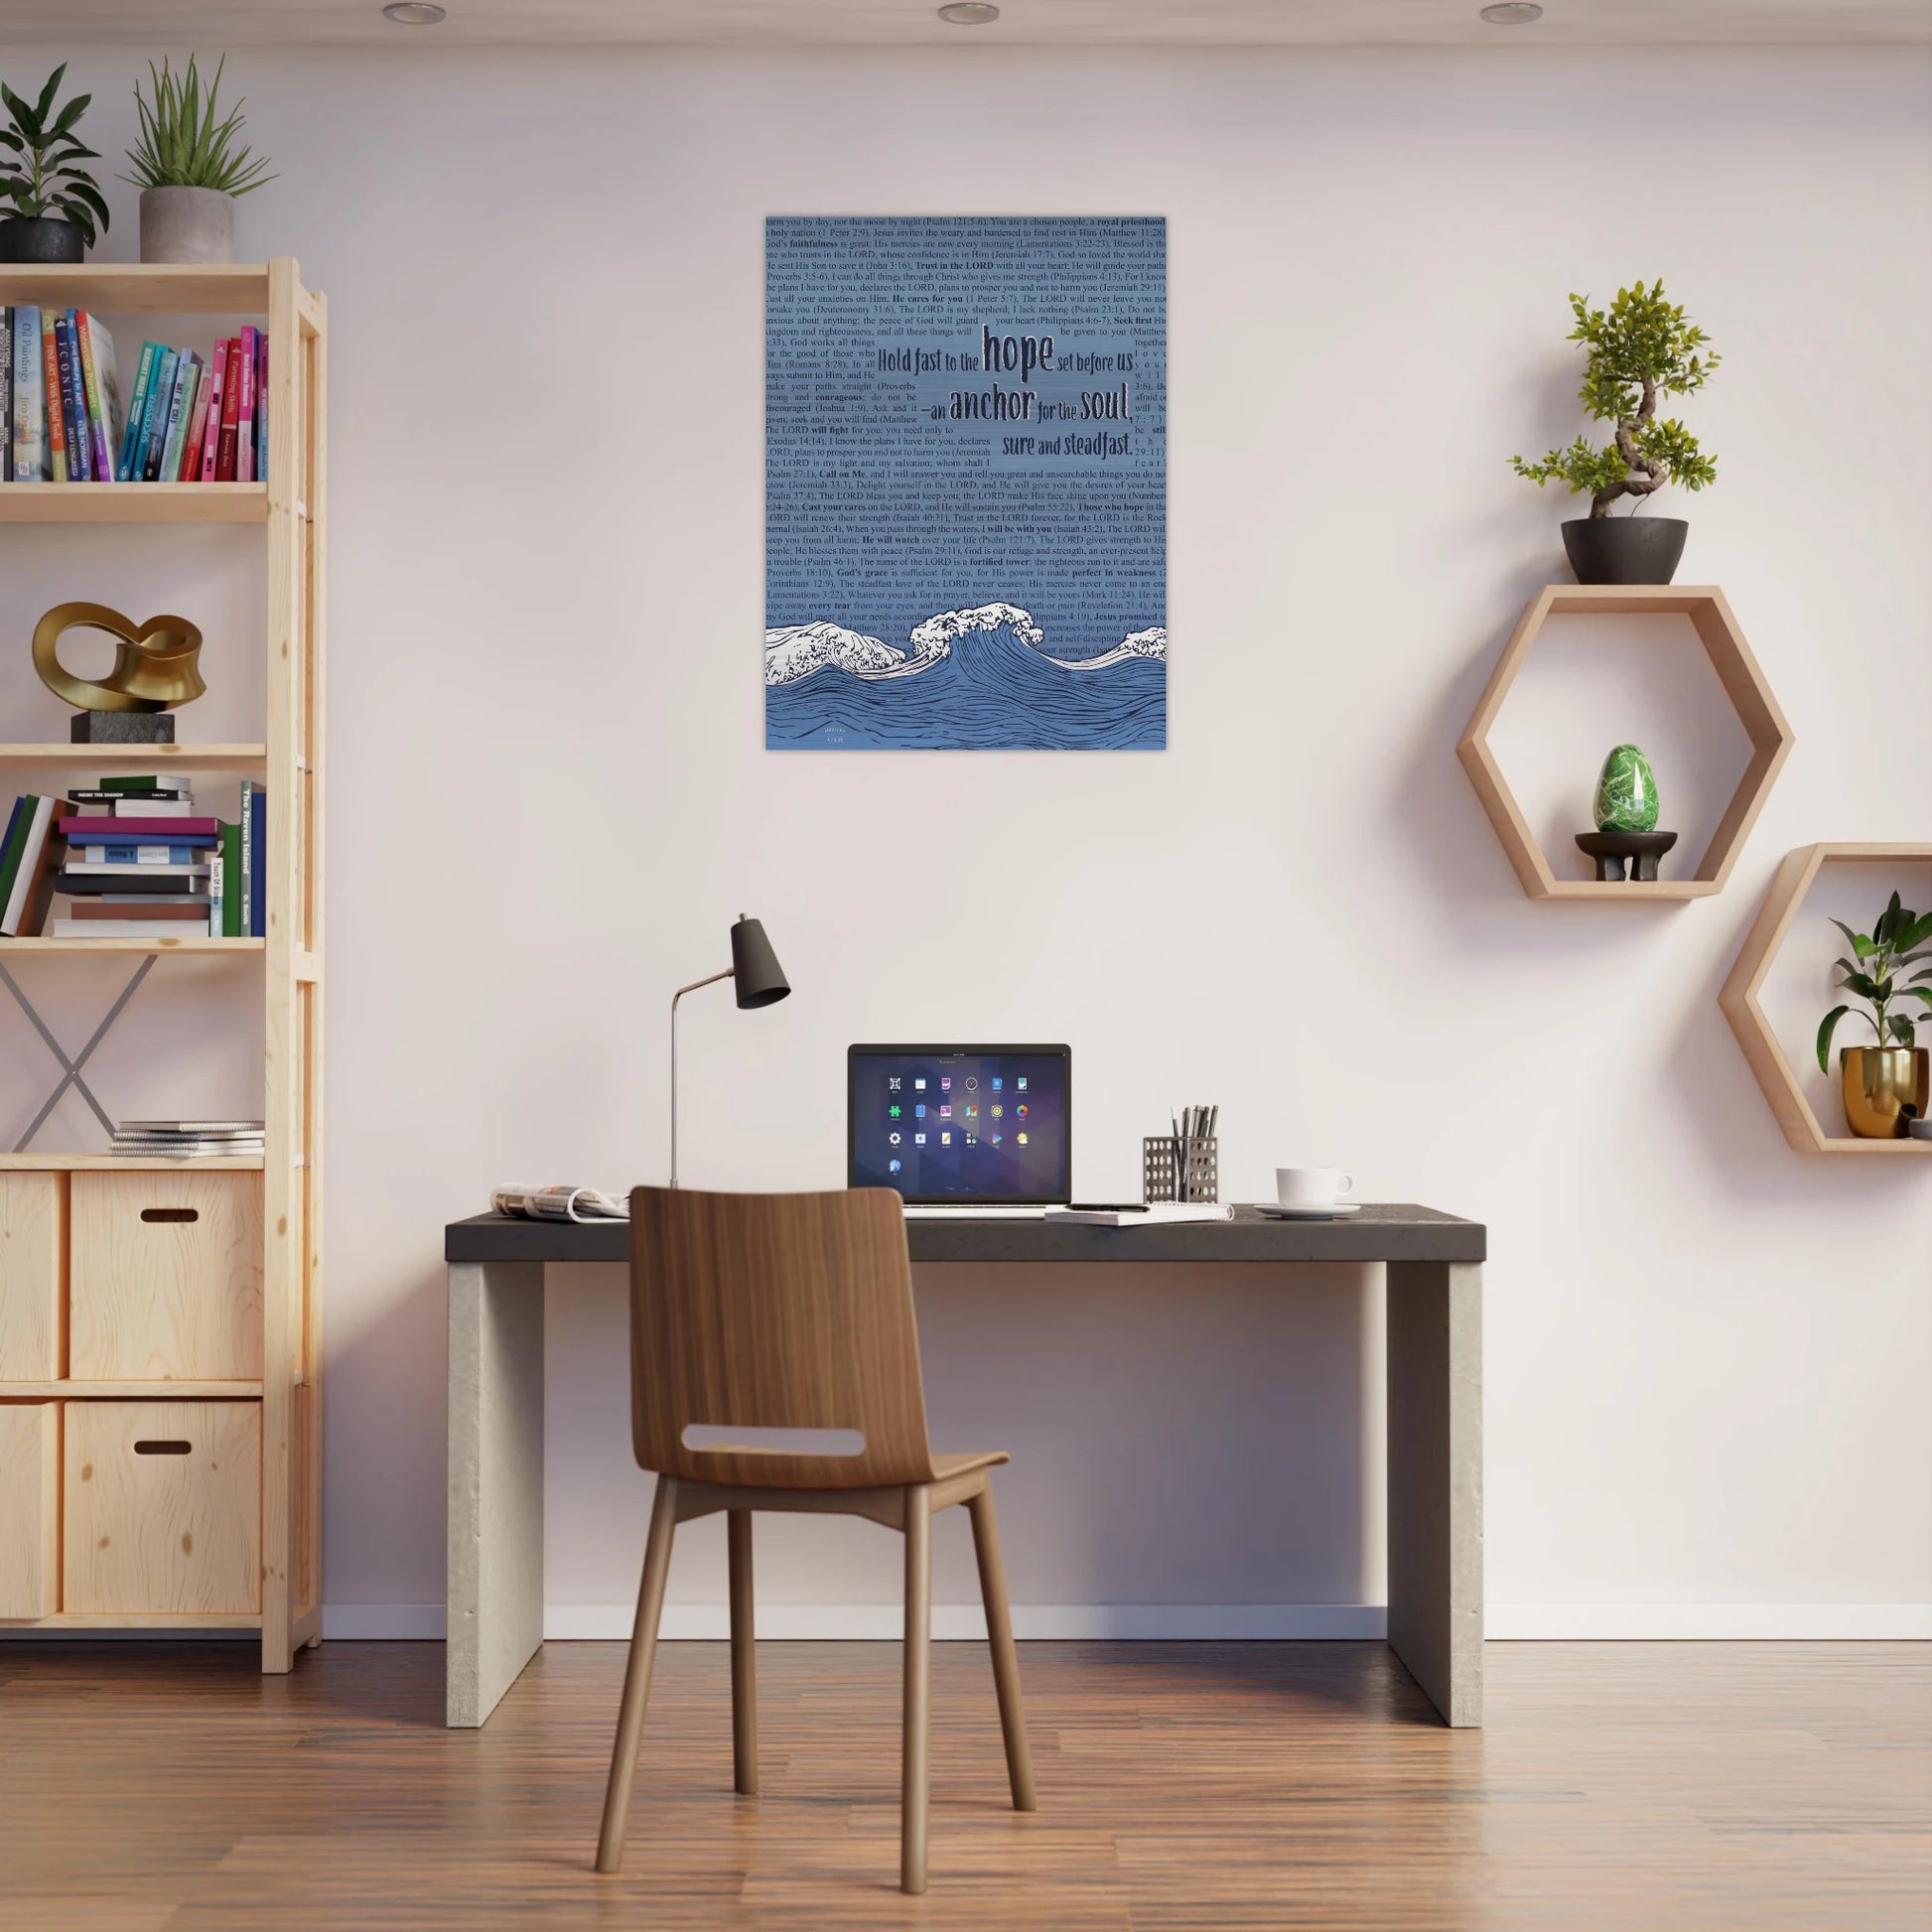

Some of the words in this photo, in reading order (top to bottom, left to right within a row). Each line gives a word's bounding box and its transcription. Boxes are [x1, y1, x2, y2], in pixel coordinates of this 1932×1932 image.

[23, 323, 32, 338] Oil
[19, 340, 32, 383] Paintings
[879, 348, 911, 371] Hold
[914, 347, 942, 376] fast
[946, 354, 957, 371] to
[960, 352, 978, 371] the
[982, 324, 1054, 383] hope
[1057, 352, 1075, 371] set
[1077, 351, 1113, 375] before
[1117, 353, 1133, 371] us
[86, 372, 97, 409] Portraits
[229, 360, 239, 393] Parenting
[51, 400, 60, 421] Digital
[228, 394, 237, 413] Skills
[949, 382, 1036, 421] anchor
[1037, 402, 1056, 424] for
[1058, 401, 1077, 420] the
[1080, 382, 1133, 424] soul,
[53, 423, 62, 439] Tools
[1003, 436, 1035, 456] sure
[1038, 436, 1060, 456] and
[1064, 432, 1133, 460] steadfast.
